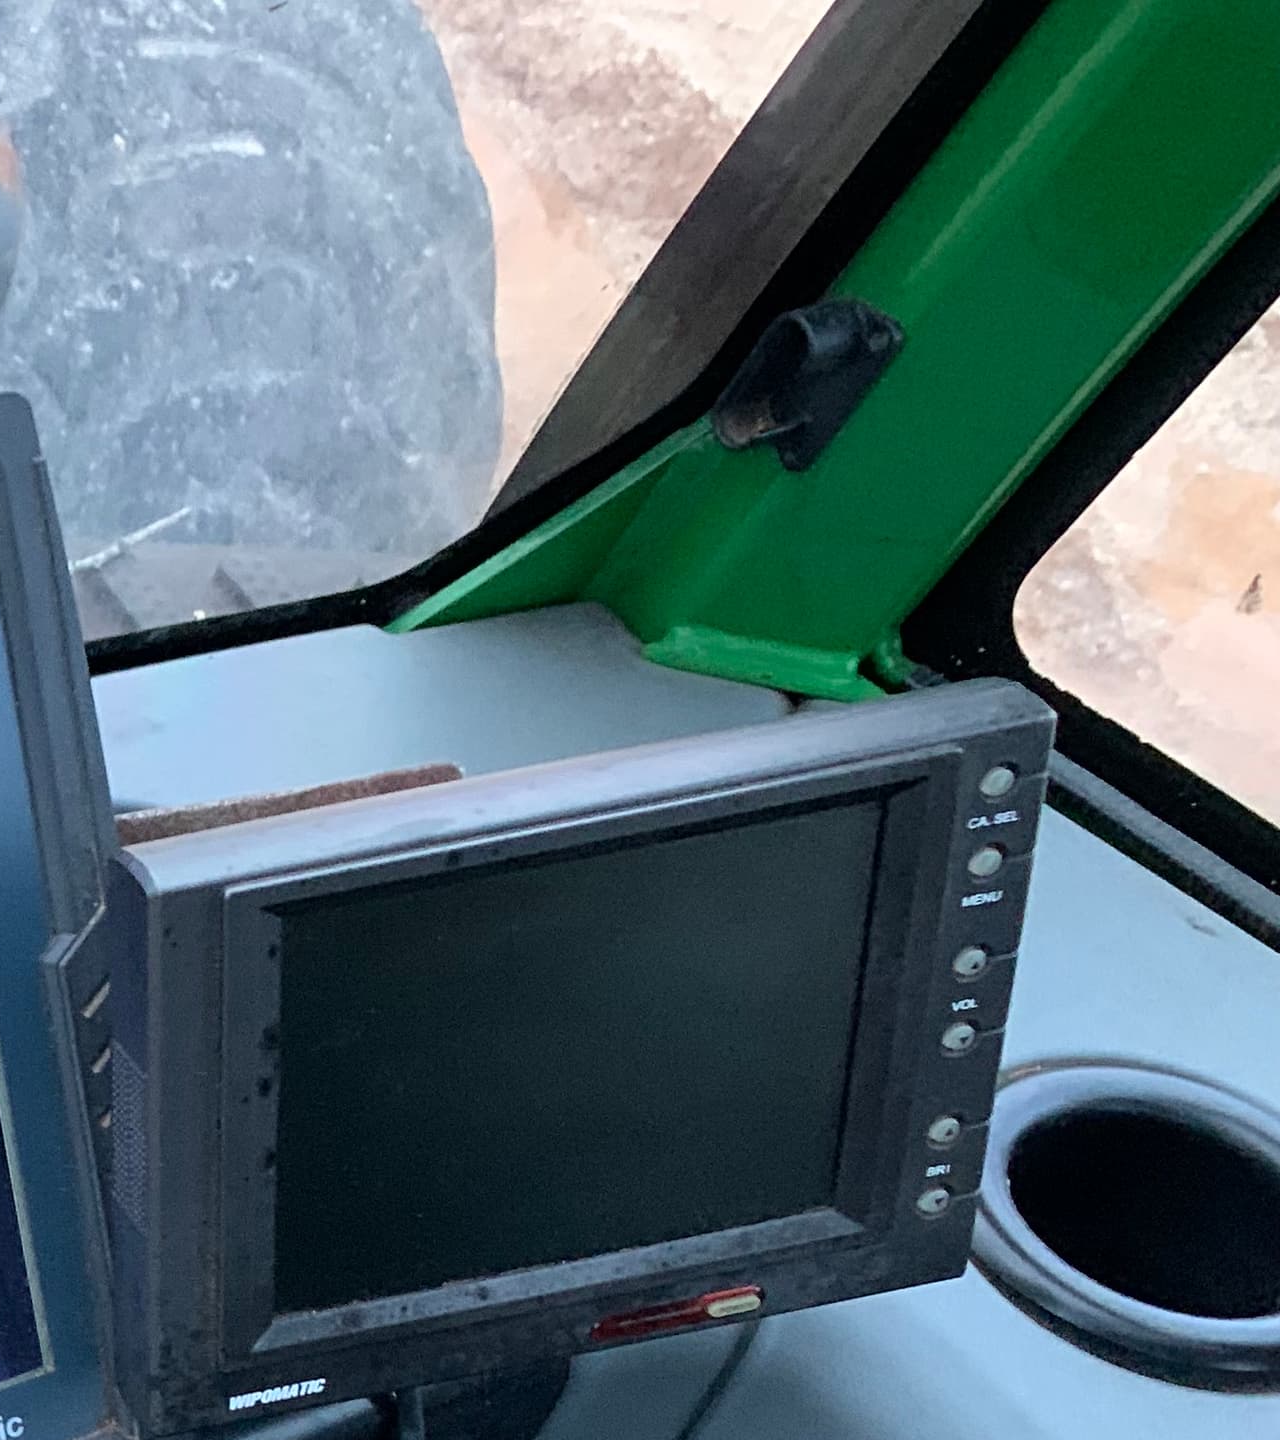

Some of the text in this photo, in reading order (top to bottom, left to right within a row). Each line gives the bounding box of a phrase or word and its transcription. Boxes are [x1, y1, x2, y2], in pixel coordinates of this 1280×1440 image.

[961, 890, 1004, 907] MENU
[951, 998, 978, 1012] VOL
[229, 1378, 326, 1410] WIPOMATIC
